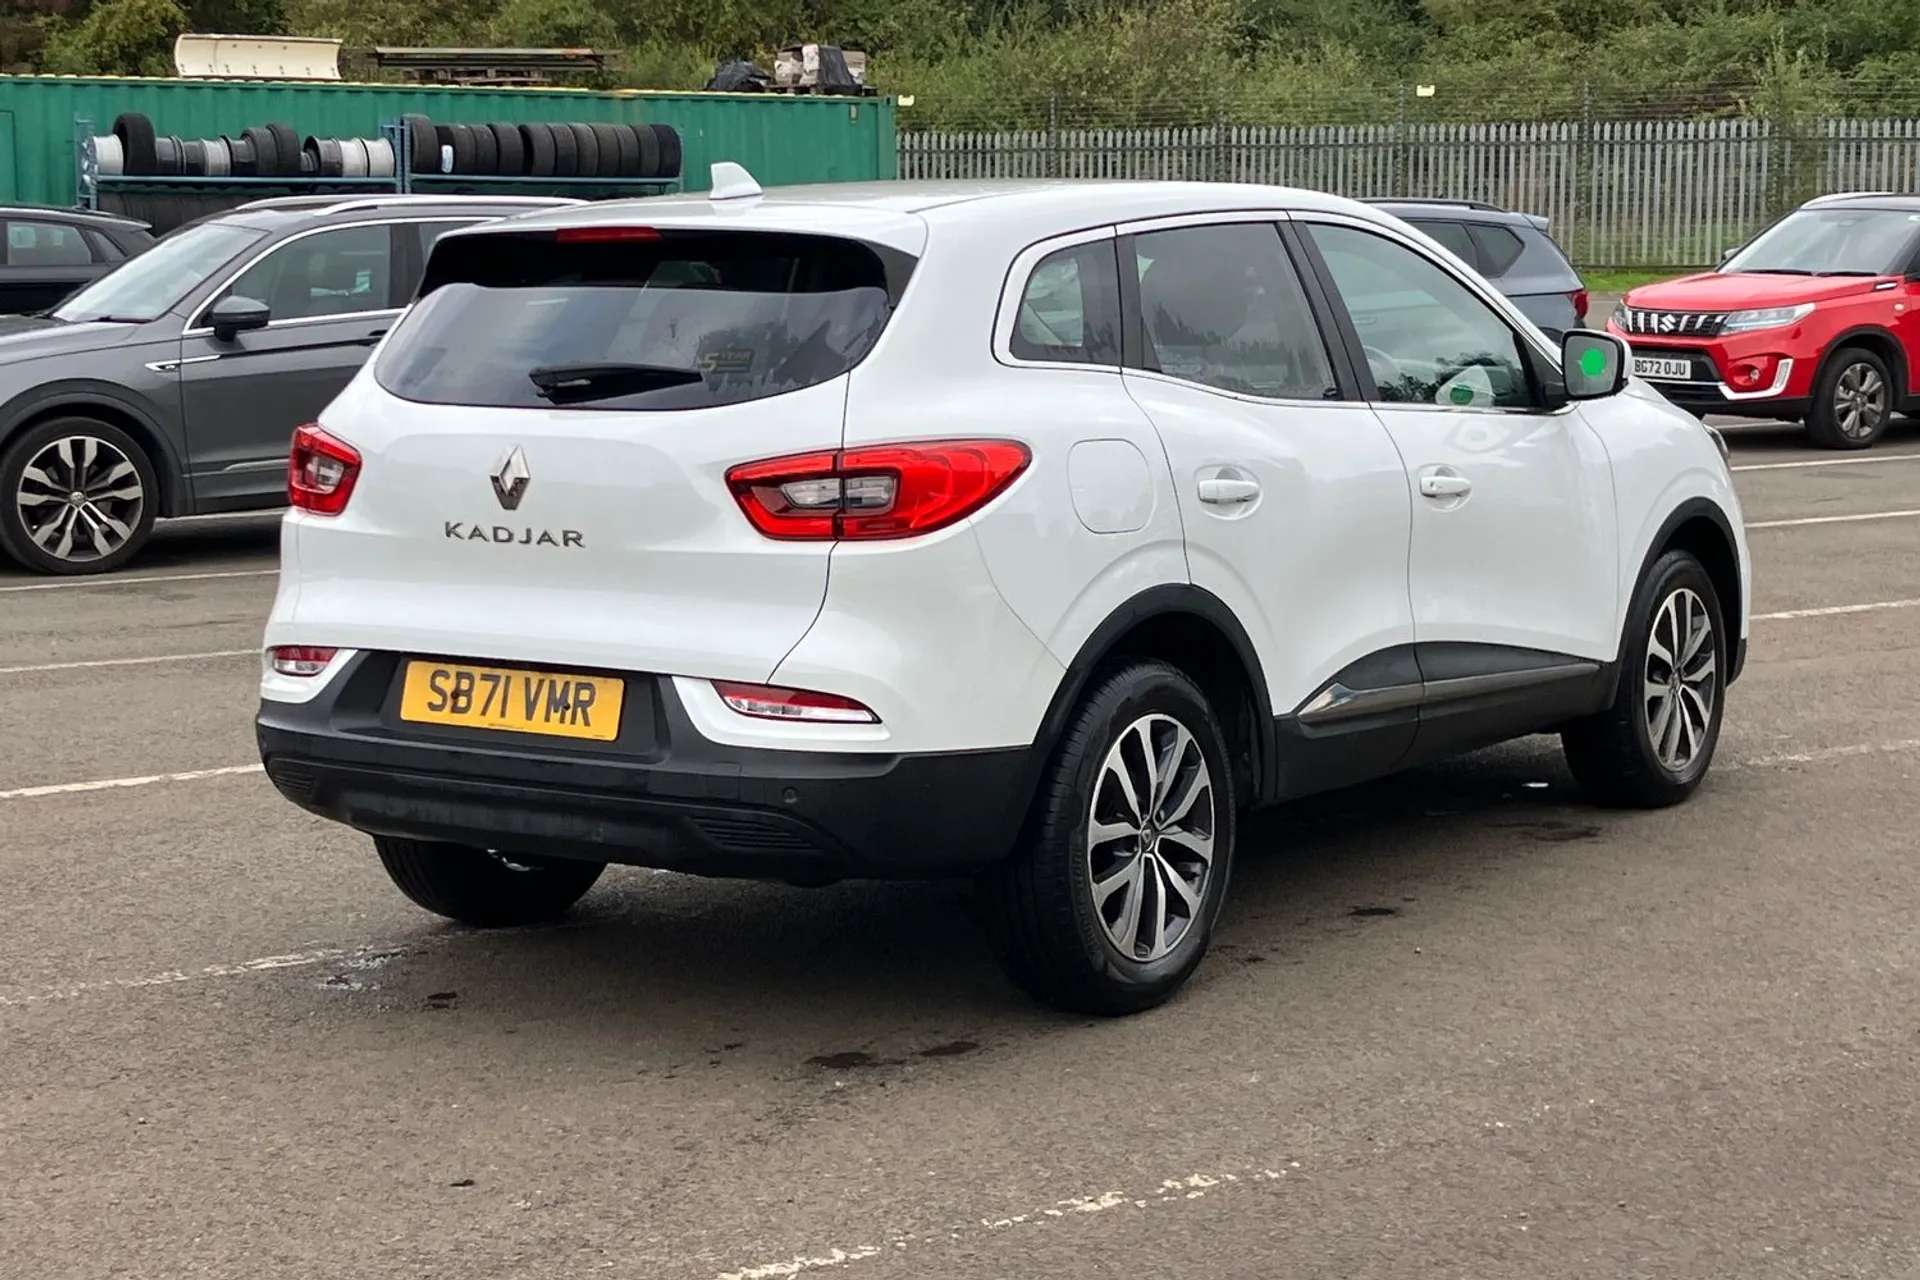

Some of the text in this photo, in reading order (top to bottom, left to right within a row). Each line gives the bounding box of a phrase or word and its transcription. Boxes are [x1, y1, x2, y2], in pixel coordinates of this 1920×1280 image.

[1635, 359, 1686, 375] BG72 OJU
[445, 521, 586, 548] KADJAR
[427, 669, 596, 727] SB71 VMR
